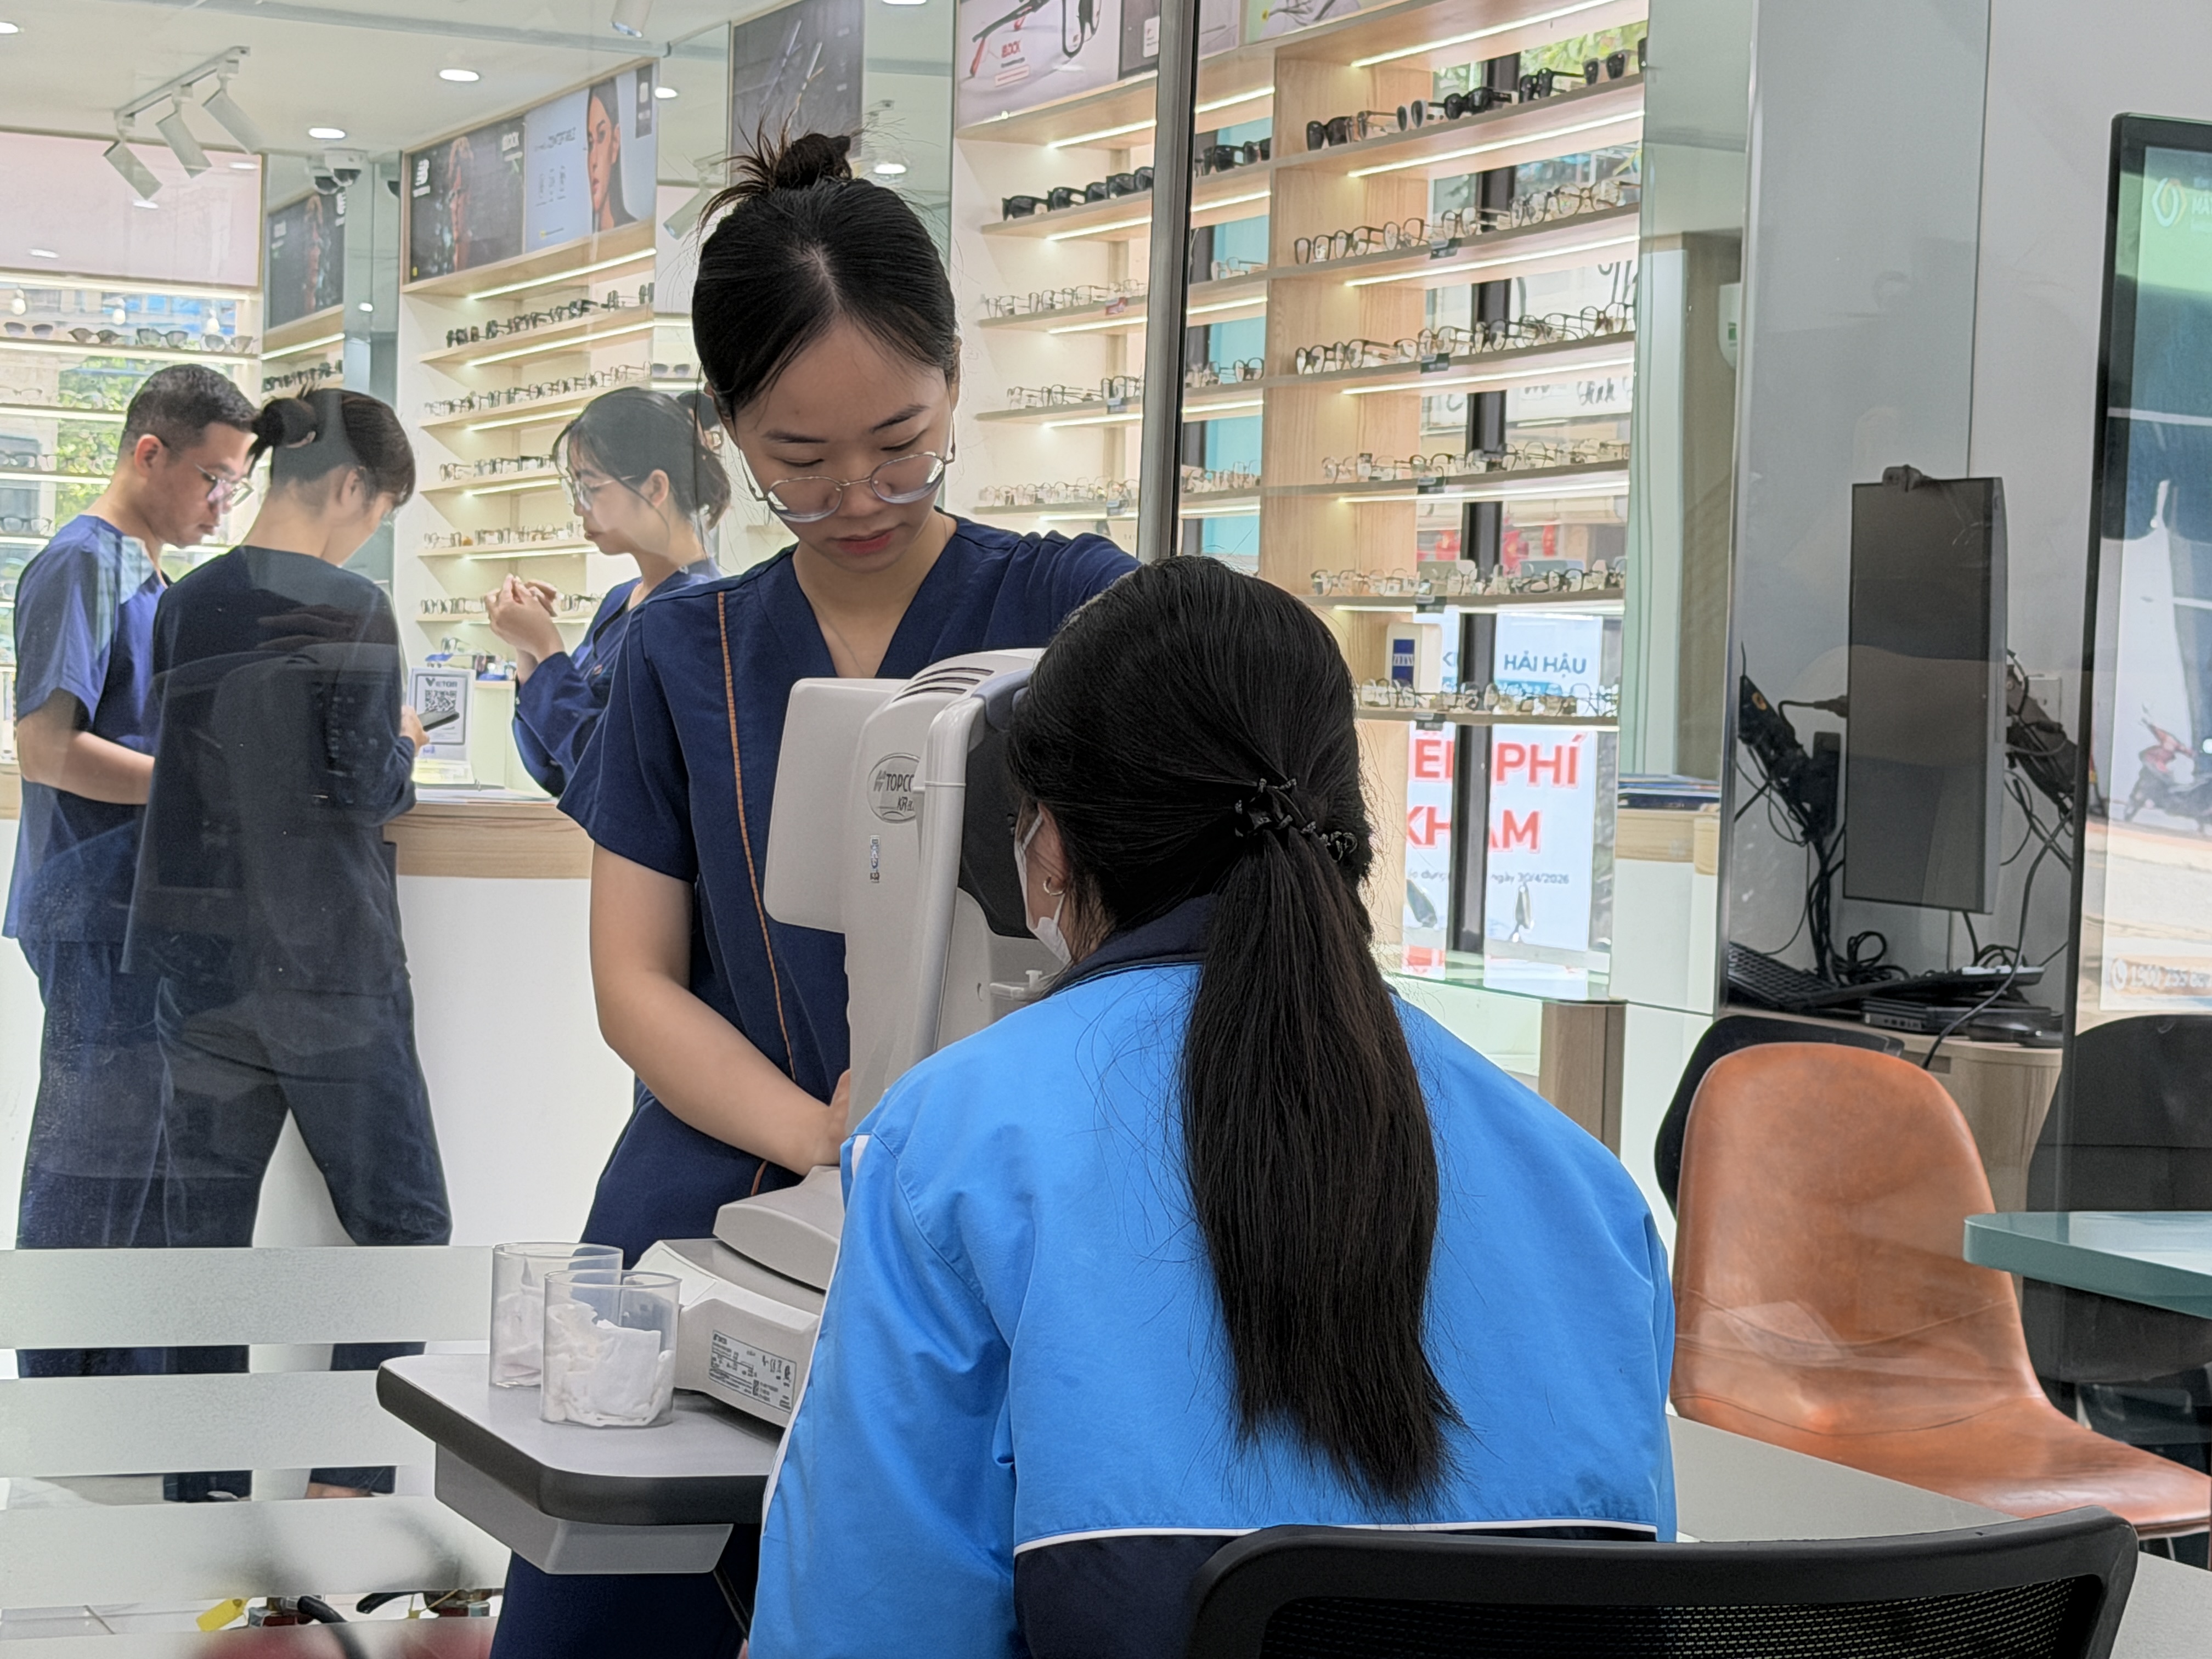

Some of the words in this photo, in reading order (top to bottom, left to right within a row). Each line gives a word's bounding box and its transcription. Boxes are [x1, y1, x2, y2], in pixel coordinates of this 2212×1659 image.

[1504, 651, 1537, 672] HẢI
[1542, 652, 1587, 679] HẬU
[1496, 734, 1583, 785] PHÍ
